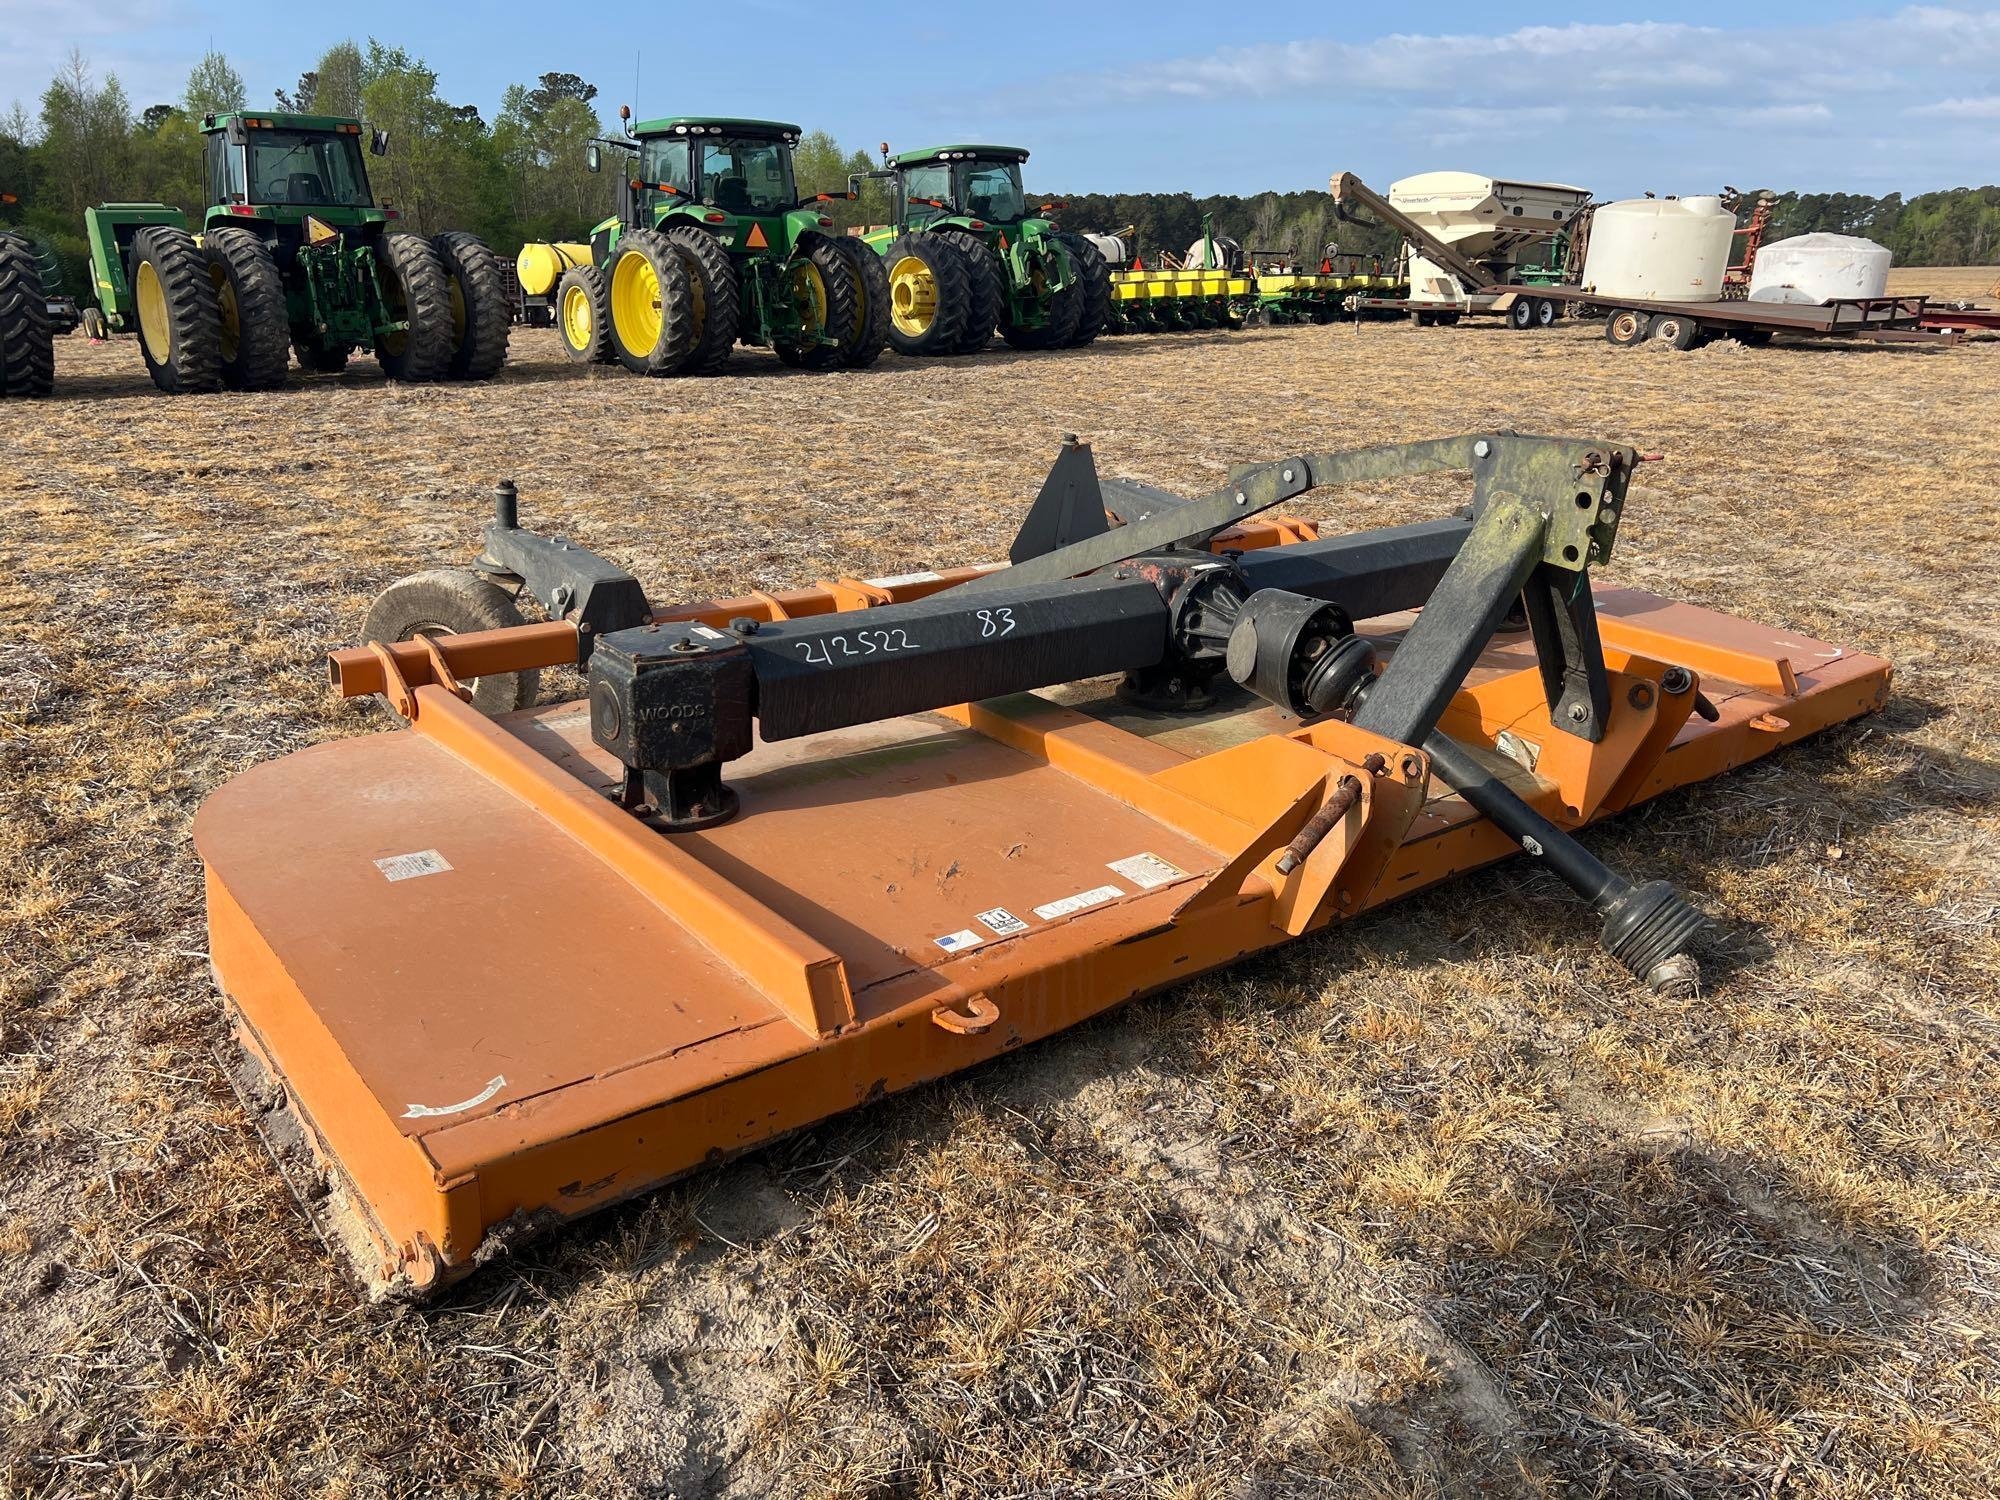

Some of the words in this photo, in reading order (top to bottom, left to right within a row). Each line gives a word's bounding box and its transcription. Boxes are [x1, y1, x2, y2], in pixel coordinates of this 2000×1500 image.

[795, 629, 921, 665] 212522
[977, 607, 1016, 638] 83
[639, 704, 706, 721] WOODS
